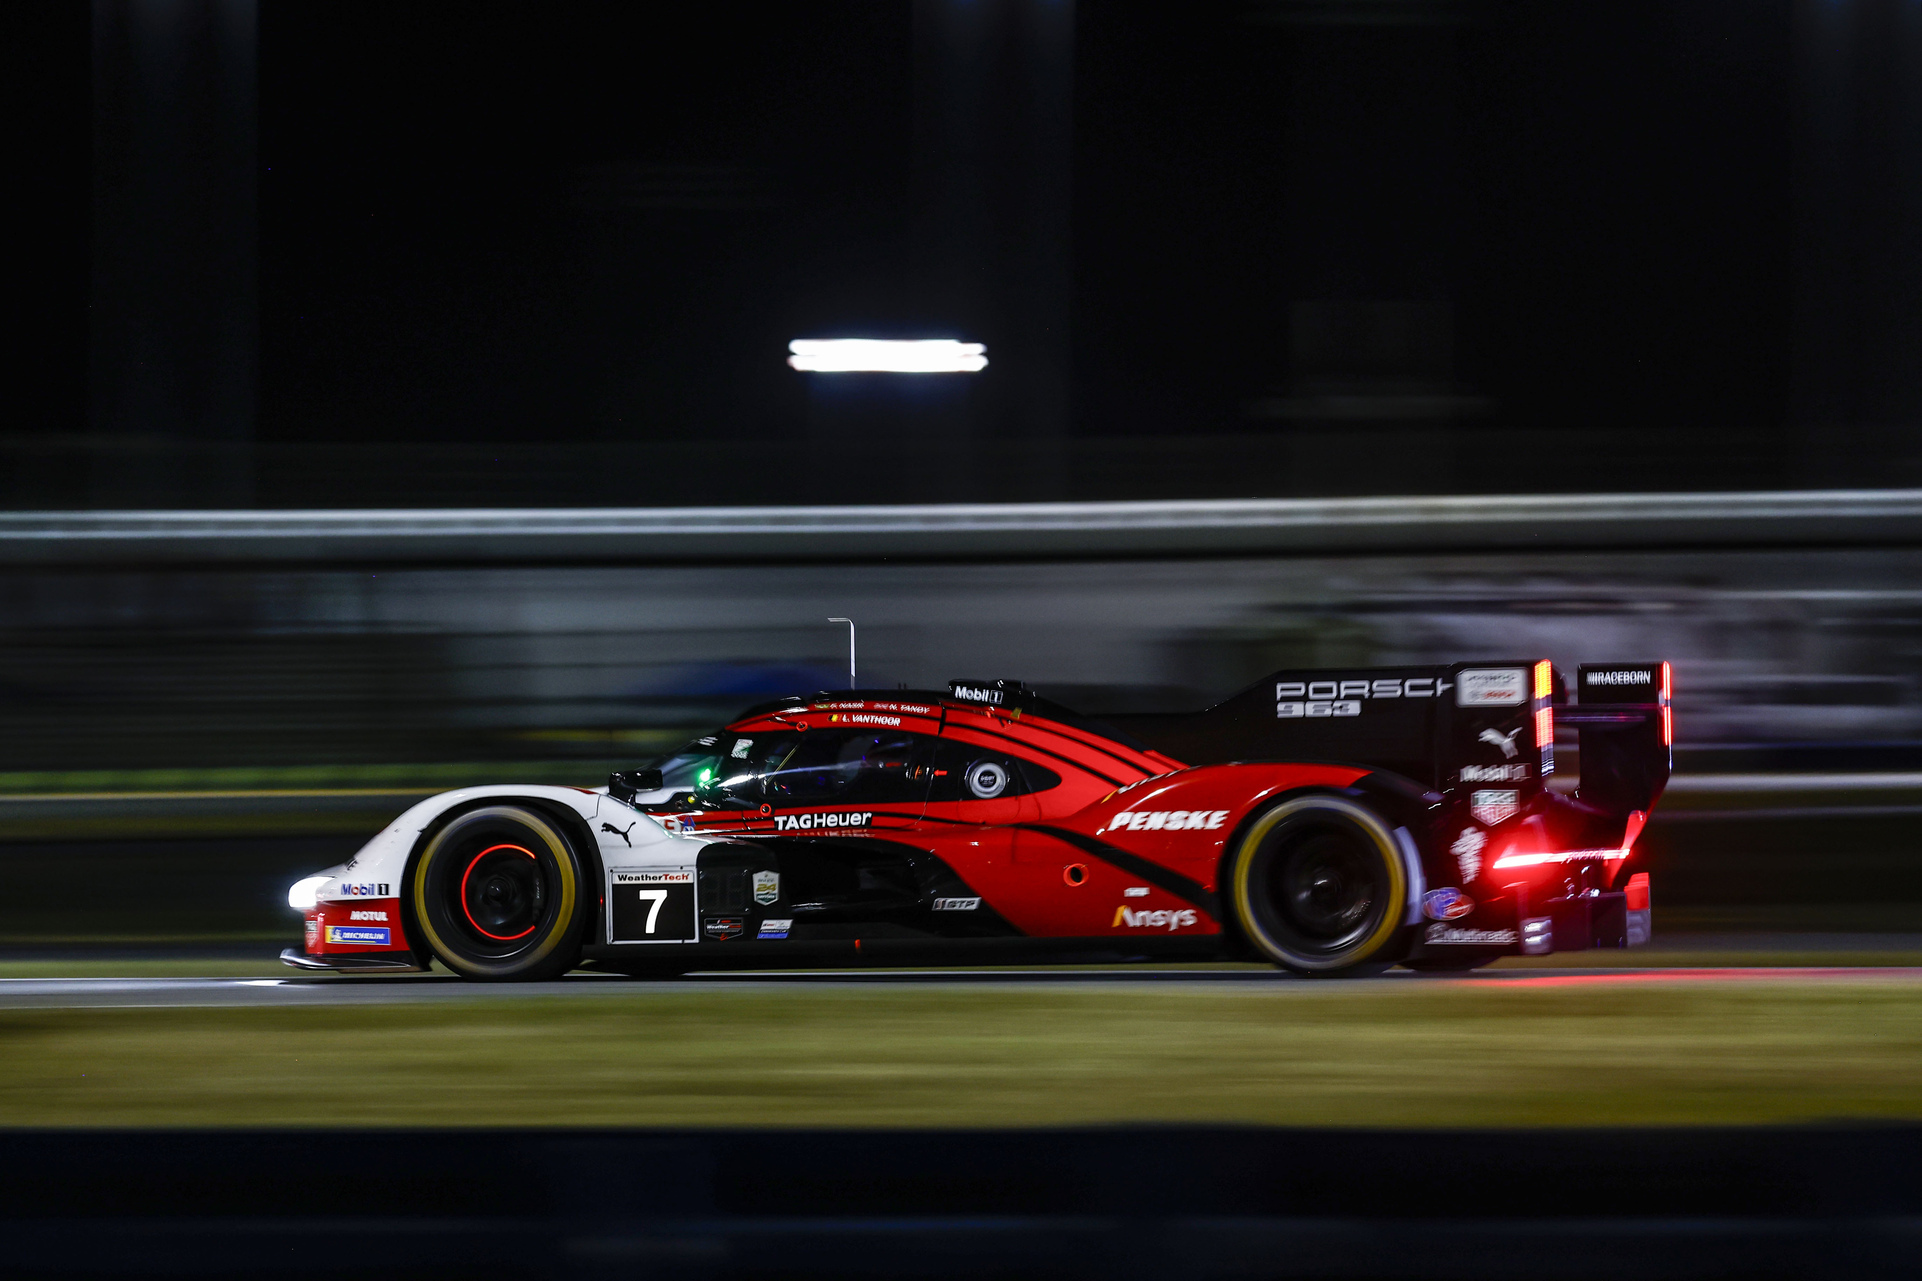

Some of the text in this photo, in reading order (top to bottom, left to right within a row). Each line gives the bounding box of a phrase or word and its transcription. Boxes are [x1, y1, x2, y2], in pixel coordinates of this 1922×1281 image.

[954, 685, 989, 703] Mobil
[1276, 699, 1362, 719] 963
[851, 714, 901, 726] VANTHOOR
[1106, 809, 1231, 832] PENSKE
[617, 873, 690, 882] WeatherTech
[341, 883, 389, 896] Mobil 1
[349, 910, 389, 922] MOTUL
[638, 889, 668, 934] 7
[1111, 904, 1198, 932] Ansys
